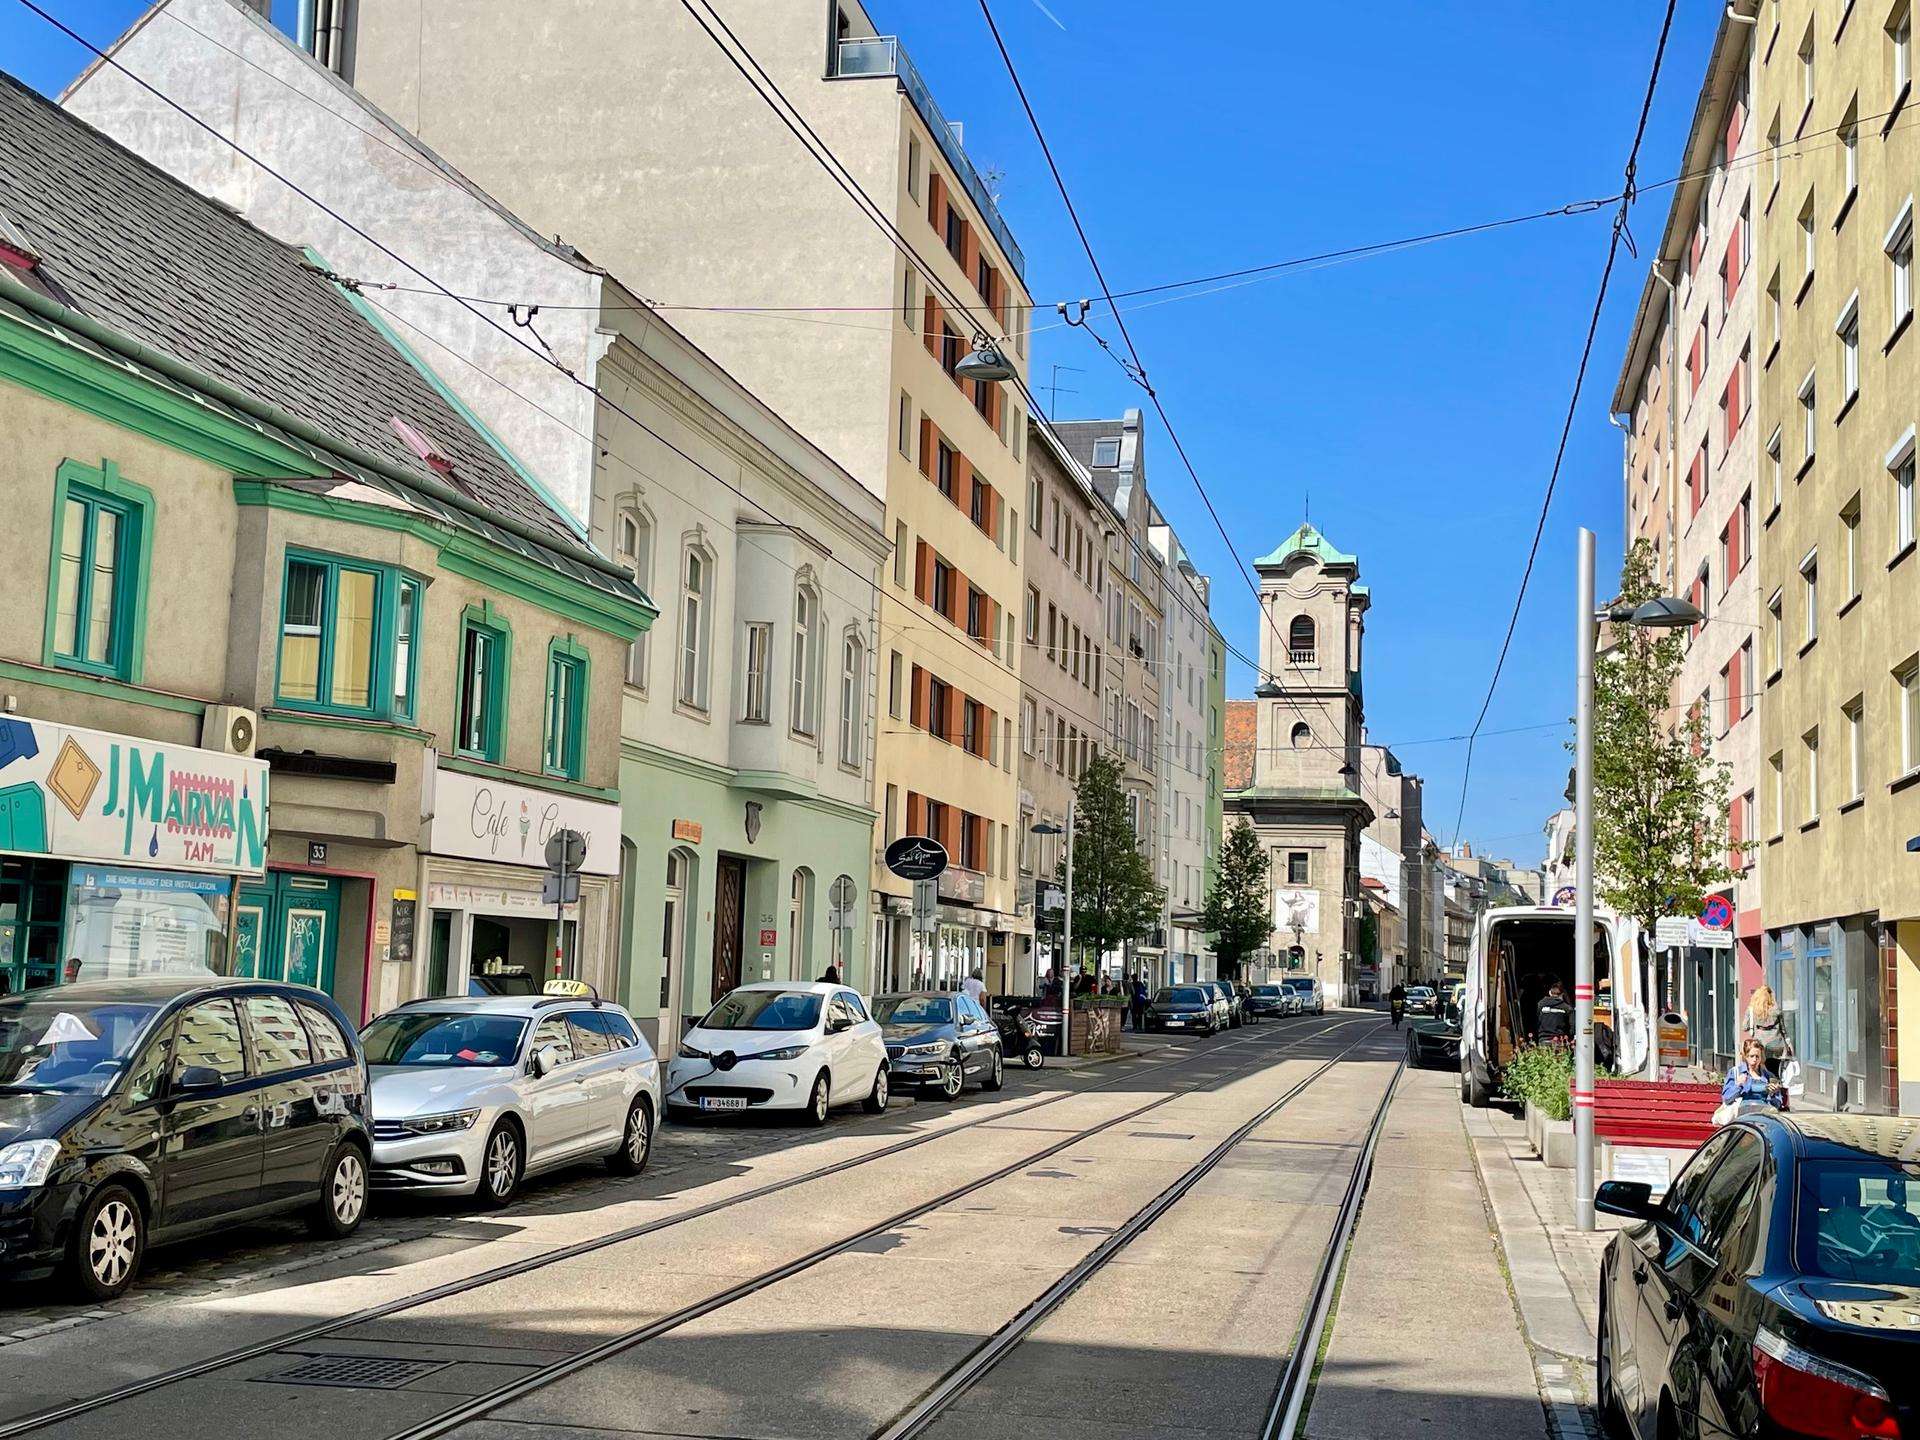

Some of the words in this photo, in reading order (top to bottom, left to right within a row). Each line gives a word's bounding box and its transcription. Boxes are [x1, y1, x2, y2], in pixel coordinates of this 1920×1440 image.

[183, 840, 214, 863] TAM
[312, 845, 325, 859] 33
[105, 874, 117, 883] DIE
[138, 877, 159, 886] KUNST
[160, 879, 174, 888] DER
[760, 913, 774, 923] 35
[547, 981, 580, 993] TAXI
